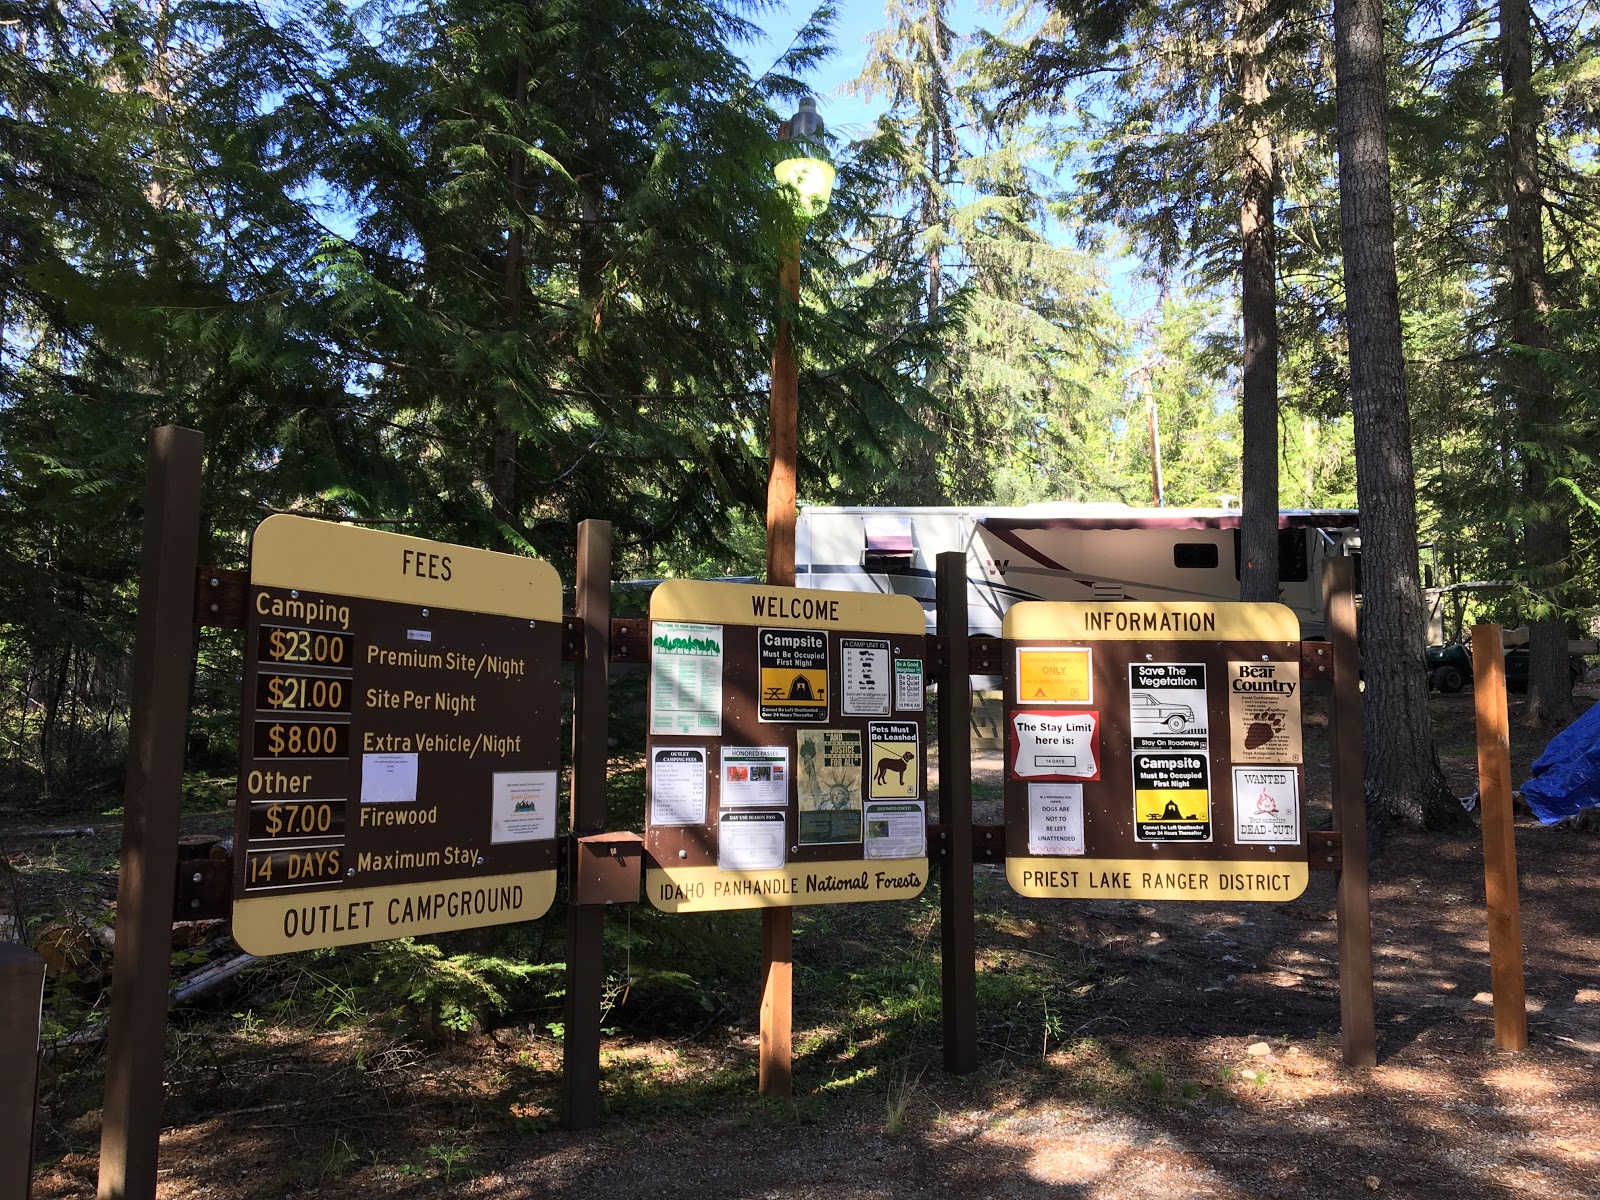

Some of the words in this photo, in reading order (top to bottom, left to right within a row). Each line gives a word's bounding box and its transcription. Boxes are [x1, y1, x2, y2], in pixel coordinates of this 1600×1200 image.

[402, 550, 452, 581] FEES
[256, 592, 350, 630] Camping
[752, 595, 839, 621] WELCOME
[1084, 612, 1216, 632] INFORMATION
[270, 629, 344, 663] $23.00
[764, 633, 823, 649] Campsite
[367, 645, 442, 669] Premium
[445, 652, 525, 679] Site/Night
[763, 650, 780, 658] Must
[782, 650, 792, 658] Be
[794, 651, 825, 660] Occupied
[776, 658, 792, 666] First
[794, 659, 812, 667] Night
[1139, 666, 1165, 676] Save
[1167, 666, 1186, 676] The
[1239, 666, 1275, 678] Bear
[268, 676, 342, 709] $21.00
[1139, 677, 1197, 688] Vegetation
[1233, 679, 1296, 698] Country
[366, 688, 400, 709] Site
[403, 690, 432, 709] Per
[435, 692, 476, 717] Night
[1017, 723, 1036, 731] The
[1040, 723, 1062, 733] Stay
[1066, 723, 1092, 731] Limit
[268, 725, 337, 757] $8.00
[363, 732, 411, 751] Extra
[415, 733, 521, 759] Vehicle/Night
[830, 746, 855, 754] JUSTICE
[1036, 736, 1059, 744] here
[1062, 736, 1074, 744] is:
[830, 758, 842, 767] FOR
[1140, 757, 1200, 770] Campsite
[248, 770, 312, 794] Other
[1244, 775, 1286, 784] WANTED
[265, 804, 331, 837] $7.00
[360, 806, 437, 827] Firewood
[1241, 825, 1266, 834] DEAD
[1273, 825, 1293, 834] OUT!
[251, 857, 272, 883] 14
[288, 850, 340, 879] DAYS
[357, 850, 440, 872] Maximum
[444, 846, 479, 867] Stay
[660, 882, 705, 900] IDAHO
[714, 878, 798, 897] PANHANDLE
[806, 872, 868, 893] National
[875, 872, 921, 890] Forests
[1023, 871, 1079, 888] PRIEST
[1090, 872, 1131, 888] LAKE
[1142, 873, 1208, 890] RANGER
[1220, 874, 1291, 891] DISTRICT
[284, 901, 374, 938] OUTLET
[388, 885, 523, 925] CAMPGROUND
